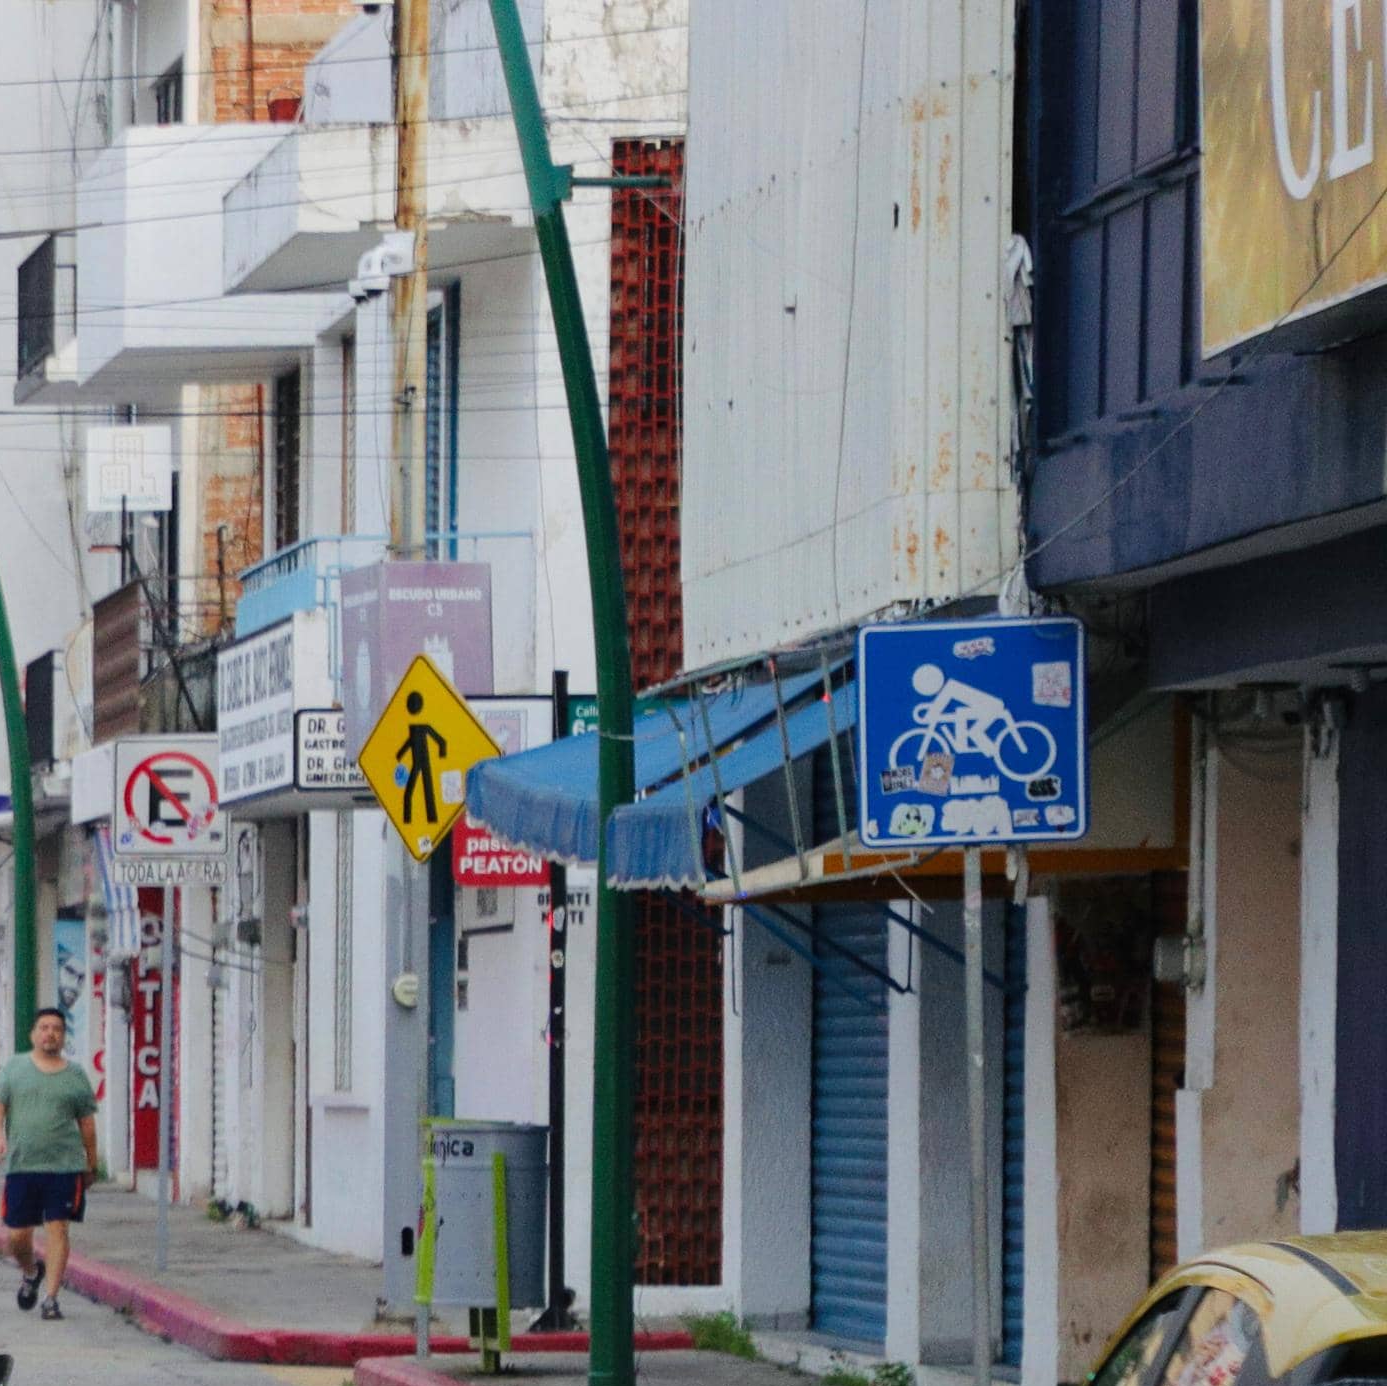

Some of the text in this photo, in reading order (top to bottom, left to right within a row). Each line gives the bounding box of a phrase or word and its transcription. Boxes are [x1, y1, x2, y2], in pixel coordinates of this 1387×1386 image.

[466, 836, 510, 857] pas
[120, 860, 222, 883] TODA LA ARA
[459, 853, 543, 876] PEATÓN
